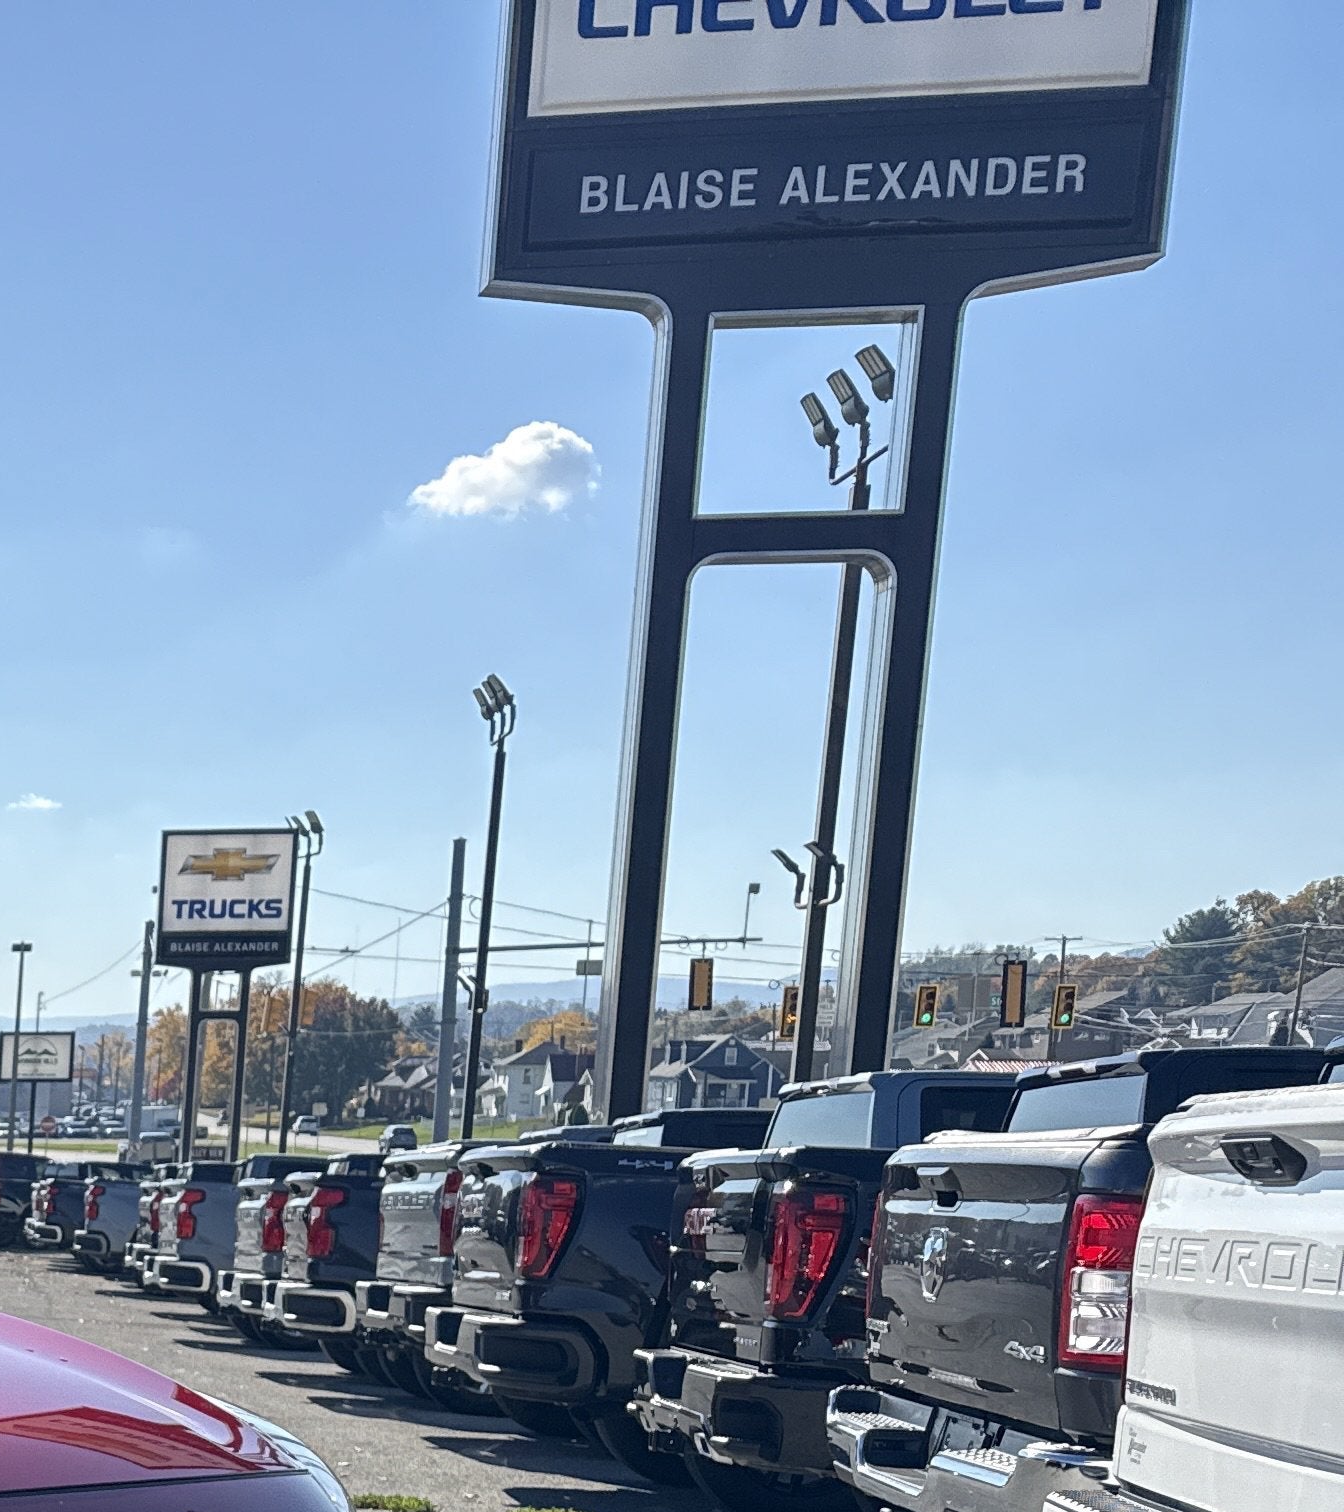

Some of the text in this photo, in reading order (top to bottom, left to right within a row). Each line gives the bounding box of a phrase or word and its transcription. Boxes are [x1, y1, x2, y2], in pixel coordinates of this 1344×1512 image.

[579, 153, 1087, 215] BLAISE ALEXANDER
[171, 898, 283, 920] TRUCKS
[169, 941, 279, 953] BLAISE ALEXANDER
[1134, 1235, 1344, 1296] CHEVROL
